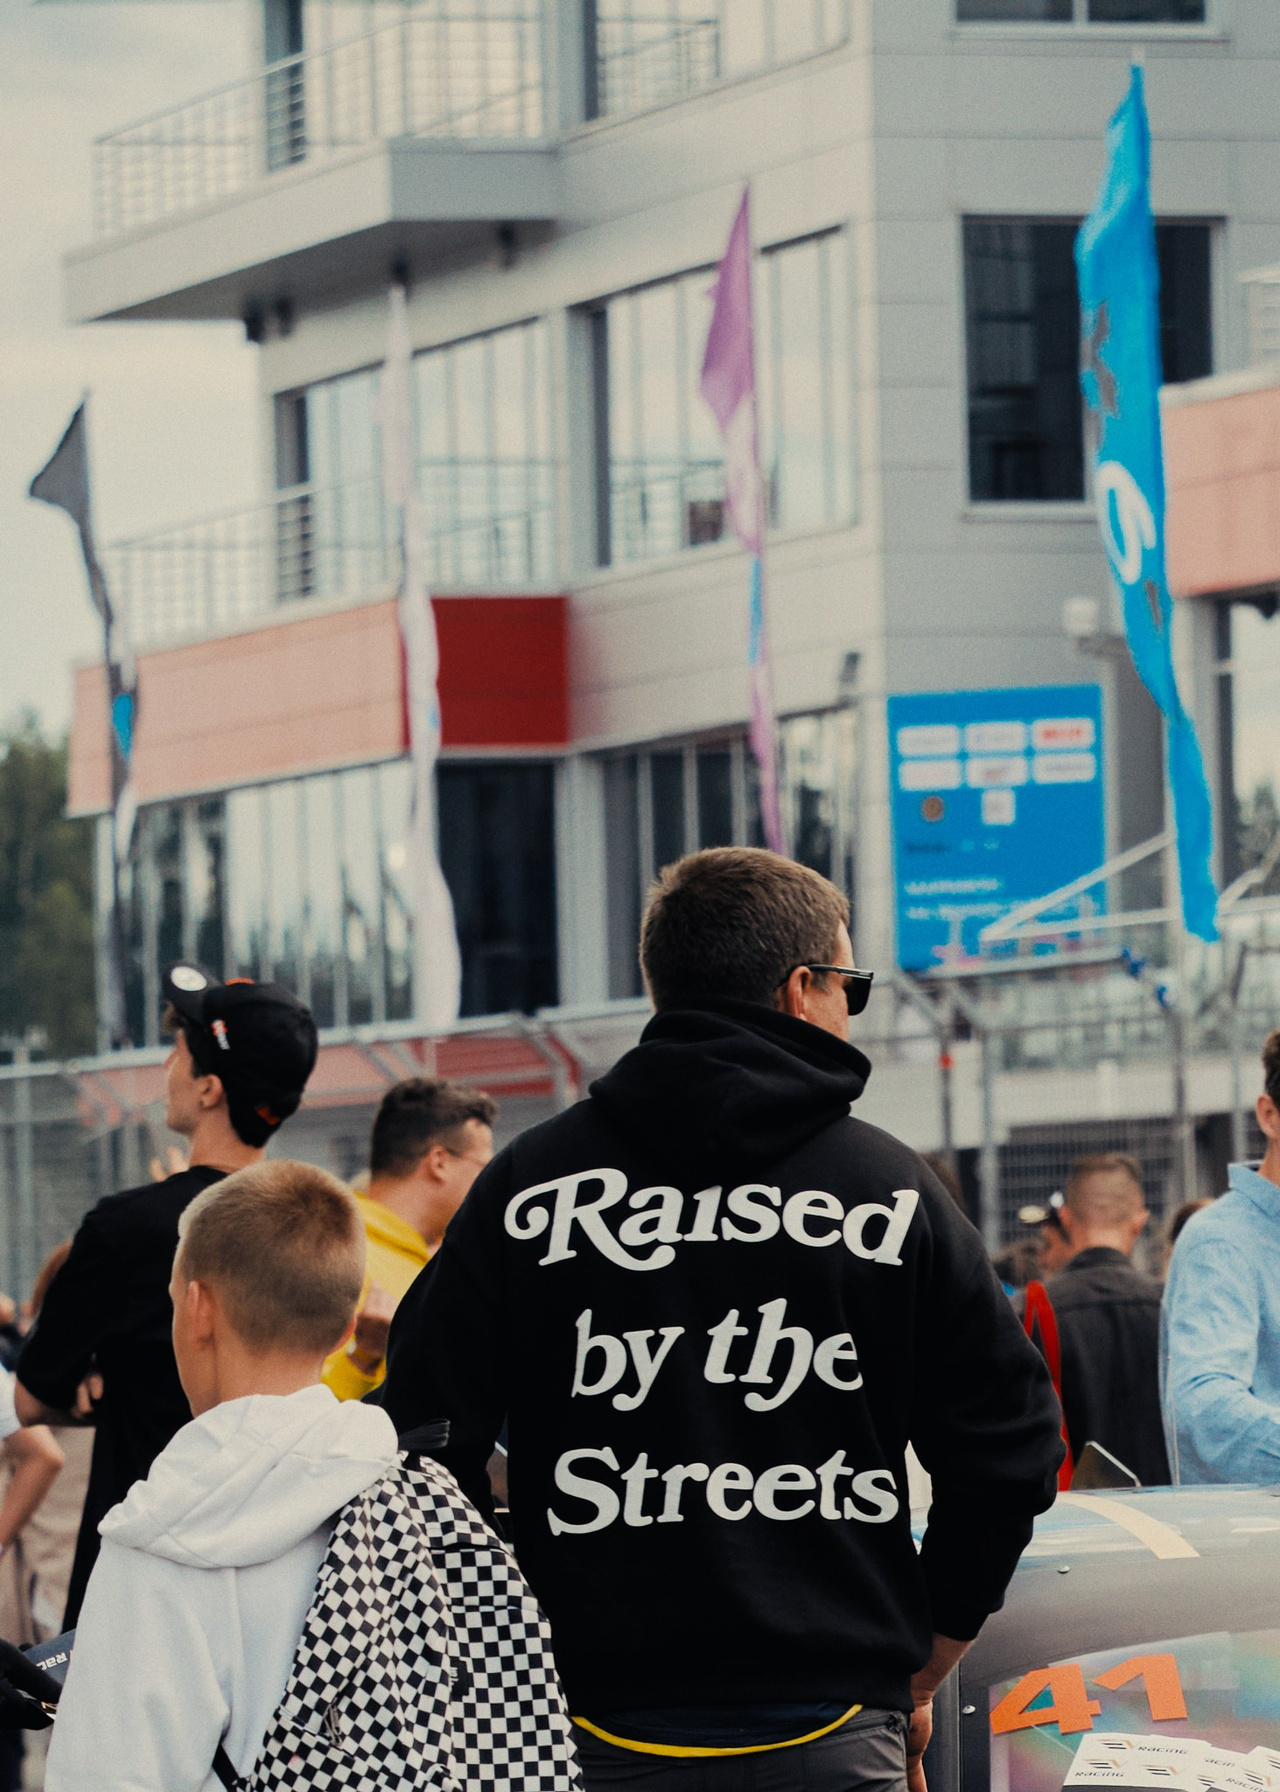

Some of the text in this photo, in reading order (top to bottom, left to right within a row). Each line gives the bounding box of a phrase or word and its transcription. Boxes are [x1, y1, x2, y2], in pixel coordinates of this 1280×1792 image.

[504, 1168, 919, 1271] Raised
[571, 1298, 863, 1412] by the
[546, 1446, 899, 1536] Streets
[989, 1653, 1189, 1735] 41
